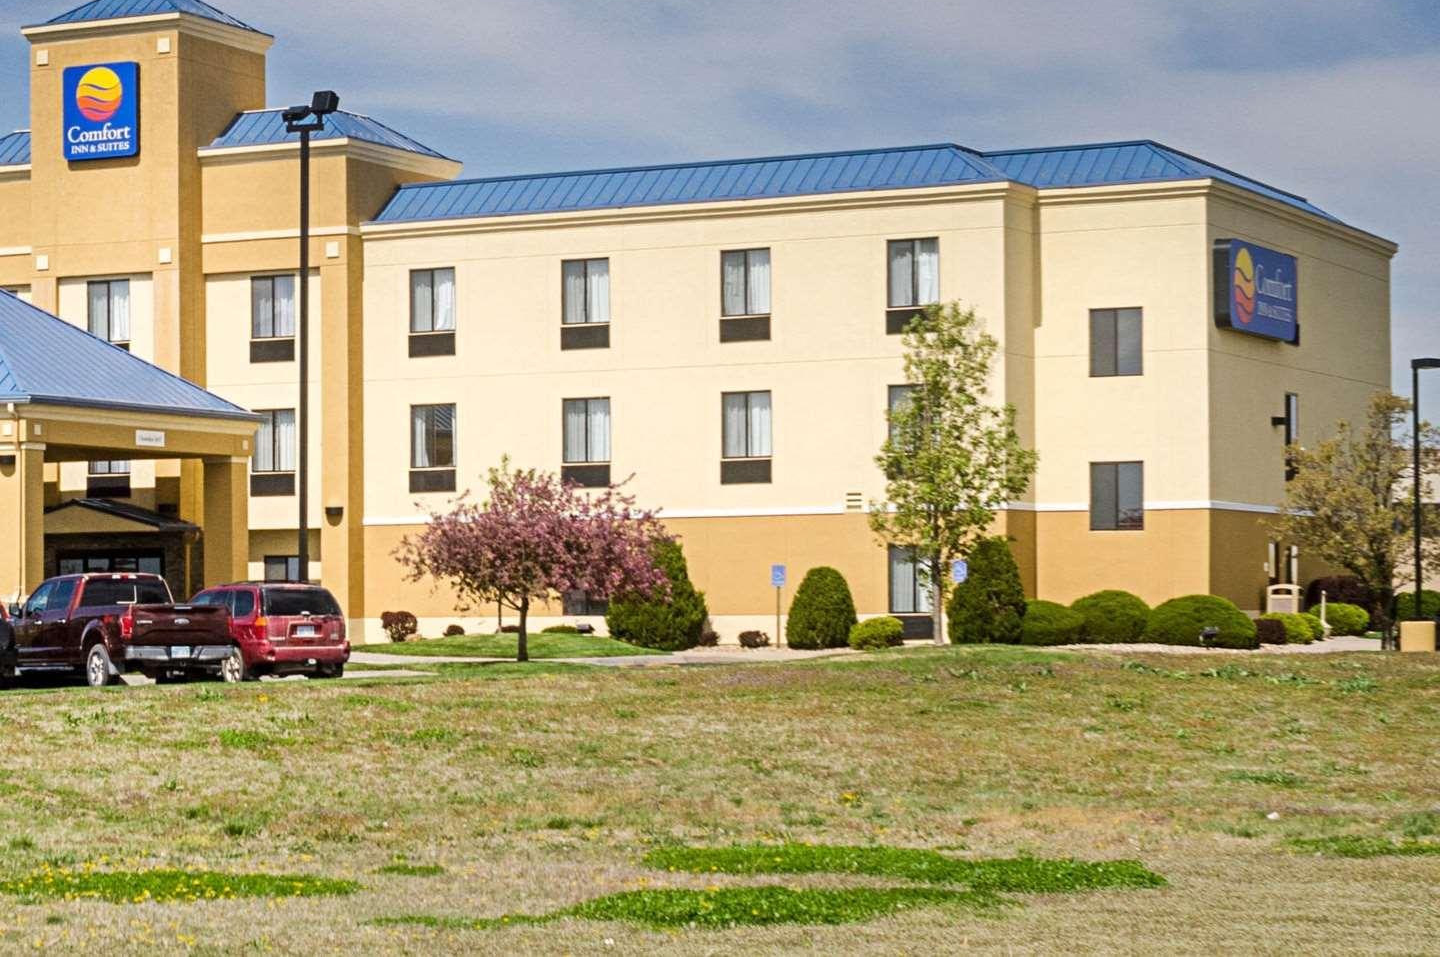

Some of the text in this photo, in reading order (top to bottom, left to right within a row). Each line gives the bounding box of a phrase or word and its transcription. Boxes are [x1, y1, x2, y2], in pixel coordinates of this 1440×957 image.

[68, 122, 130, 143] Comfort
[71, 141, 130, 154] INN & SUITES
